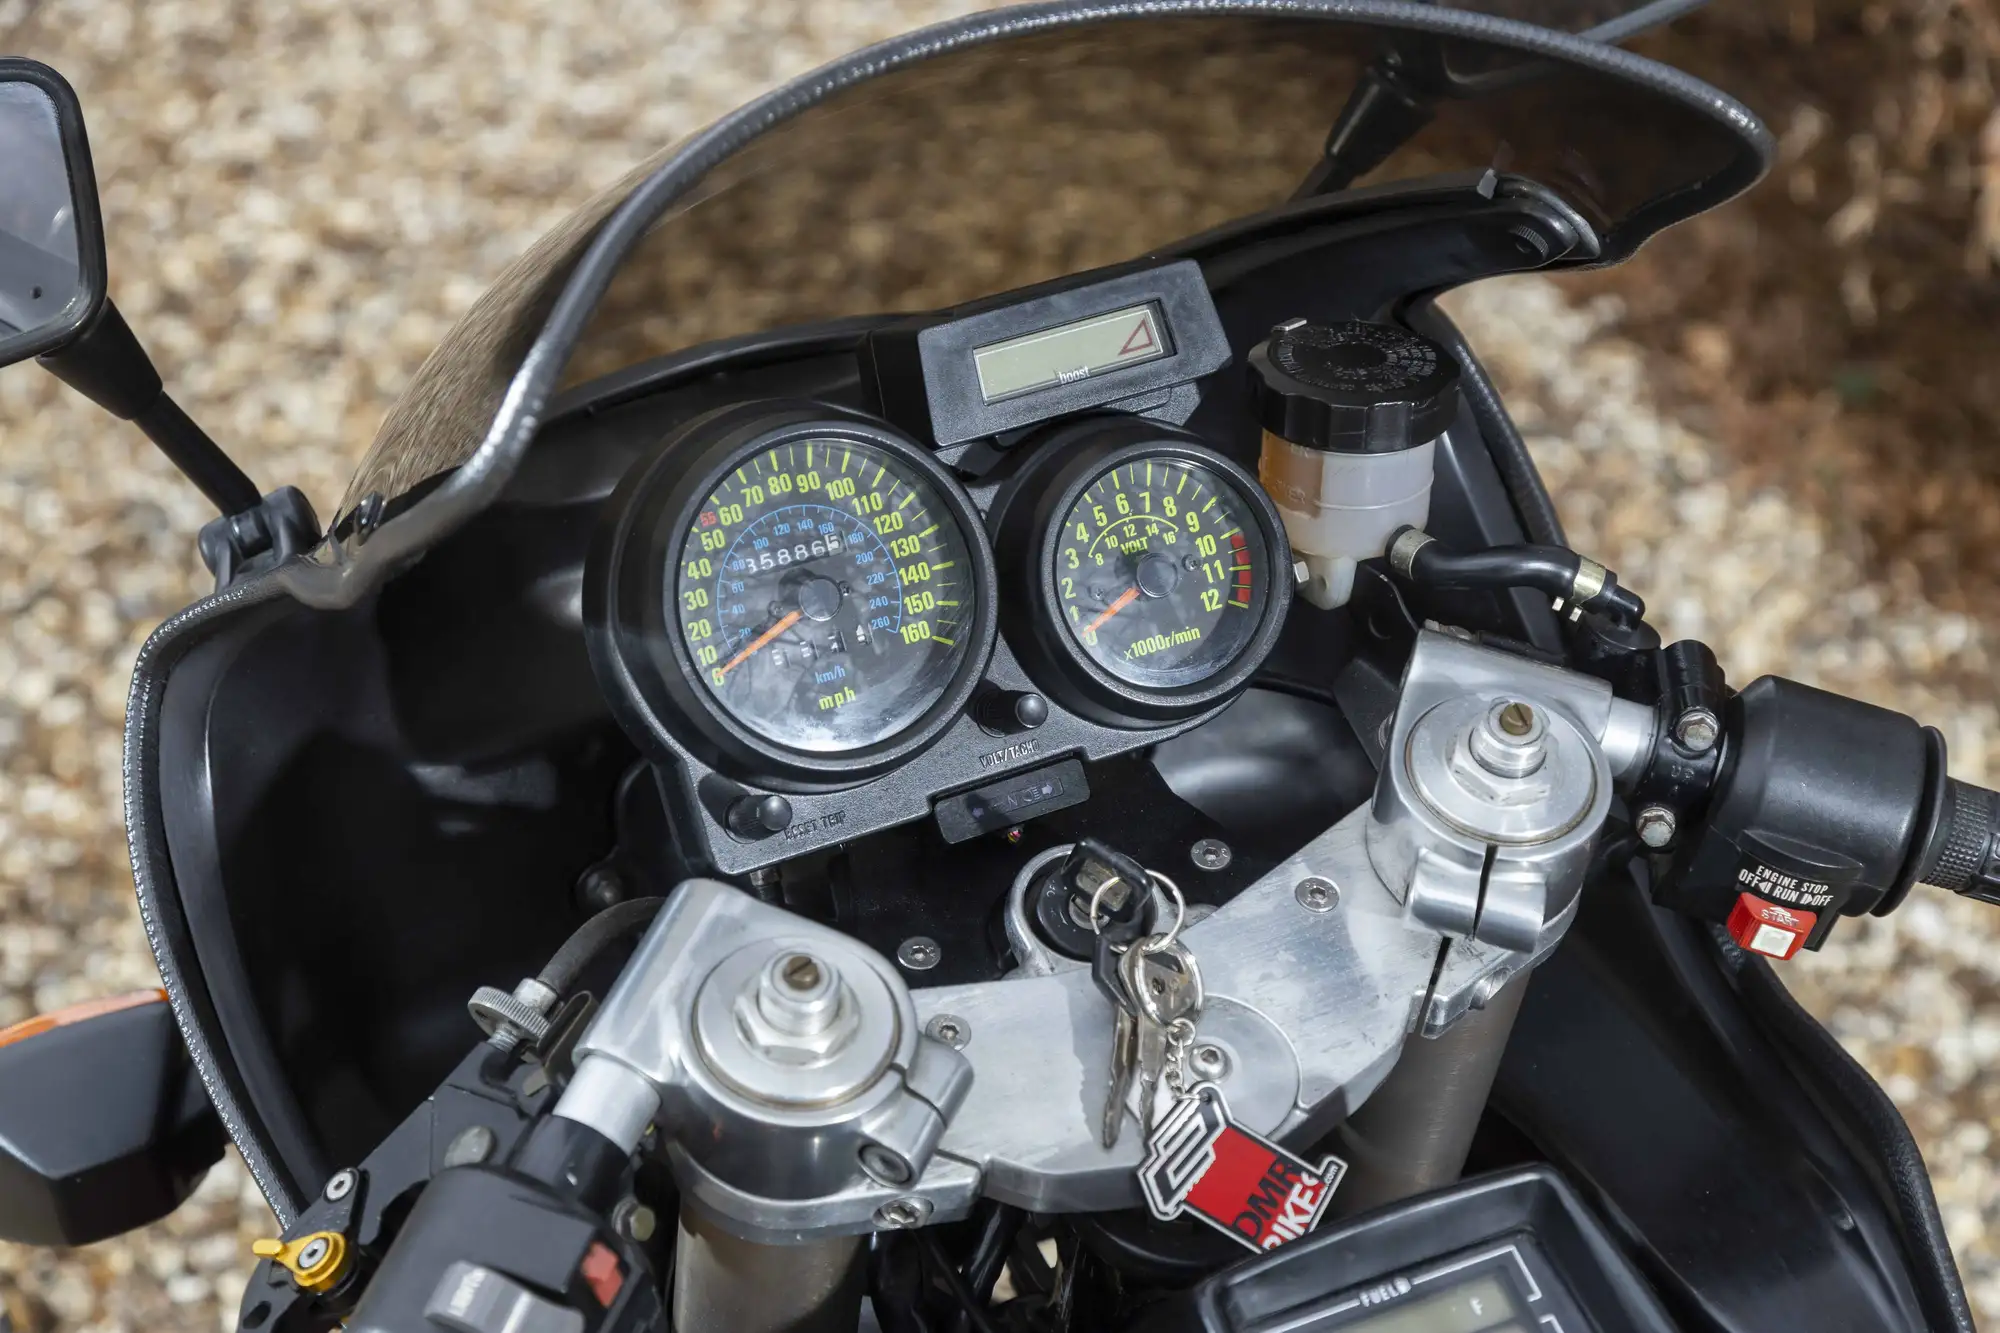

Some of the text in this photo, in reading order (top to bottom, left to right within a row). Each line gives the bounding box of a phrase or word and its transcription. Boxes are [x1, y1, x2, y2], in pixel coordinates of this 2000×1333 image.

[1059, 365, 1090, 384] boost
[768, 473, 792, 496] 80
[796, 471, 821, 493] 90
[825, 477, 856, 500] 100
[740, 485, 764, 507] 70
[852, 492, 883, 516] 110
[1115, 493, 1130, 514] 6
[1139, 492, 1151, 513] 7
[1163, 496, 1177, 517] 8
[719, 504, 743, 526] 60
[797, 519, 813, 531] 140
[873, 512, 903, 535] 120
[1093, 505, 1108, 526] 5
[1186, 511, 1200, 533] 9
[773, 523, 790, 536] 120
[818, 522, 834, 536] 160
[848, 532, 864, 545] 180
[1076, 522, 1090, 543] 4
[1123, 524, 1137, 538] 12
[1145, 523, 1159, 537] 14
[1162, 533, 1176, 545] 16
[701, 529, 725, 551] 50
[752, 537, 769, 550] 100
[890, 535, 921, 558] 130
[1105, 535, 1119, 550] 10
[1120, 537, 1148, 555] VOLT
[1195, 534, 1217, 558] 10
[856, 552, 873, 564] 200
[1065, 548, 1080, 569] 3
[1095, 553, 1104, 566] 8
[687, 558, 712, 580] 40
[867, 572, 885, 585] 220
[899, 562, 930, 586] 140
[1203, 559, 1225, 583] 11
[732, 582, 744, 593] 60
[1061, 577, 1076, 599] 2
[684, 588, 709, 611] 30
[732, 604, 746, 614] 40
[870, 596, 889, 609] 240
[904, 591, 934, 615] 150
[1201, 588, 1223, 612] 12
[871, 616, 890, 630] 260
[1069, 605, 1079, 624] 1
[688, 619, 712, 641] 20
[900, 620, 930, 645] 160
[697, 645, 718, 667] 10
[815, 665, 845, 684] km/h
[819, 686, 856, 710] mph
[979, 739, 1039, 768] VOLT/TACHO
[820, 810, 846, 828] TRIP
[1739, 868, 1834, 906] OFF RUN OFF
[1756, 865, 1829, 895] ENGINE STOP
[1232, 1160, 1300, 1241] DMR
